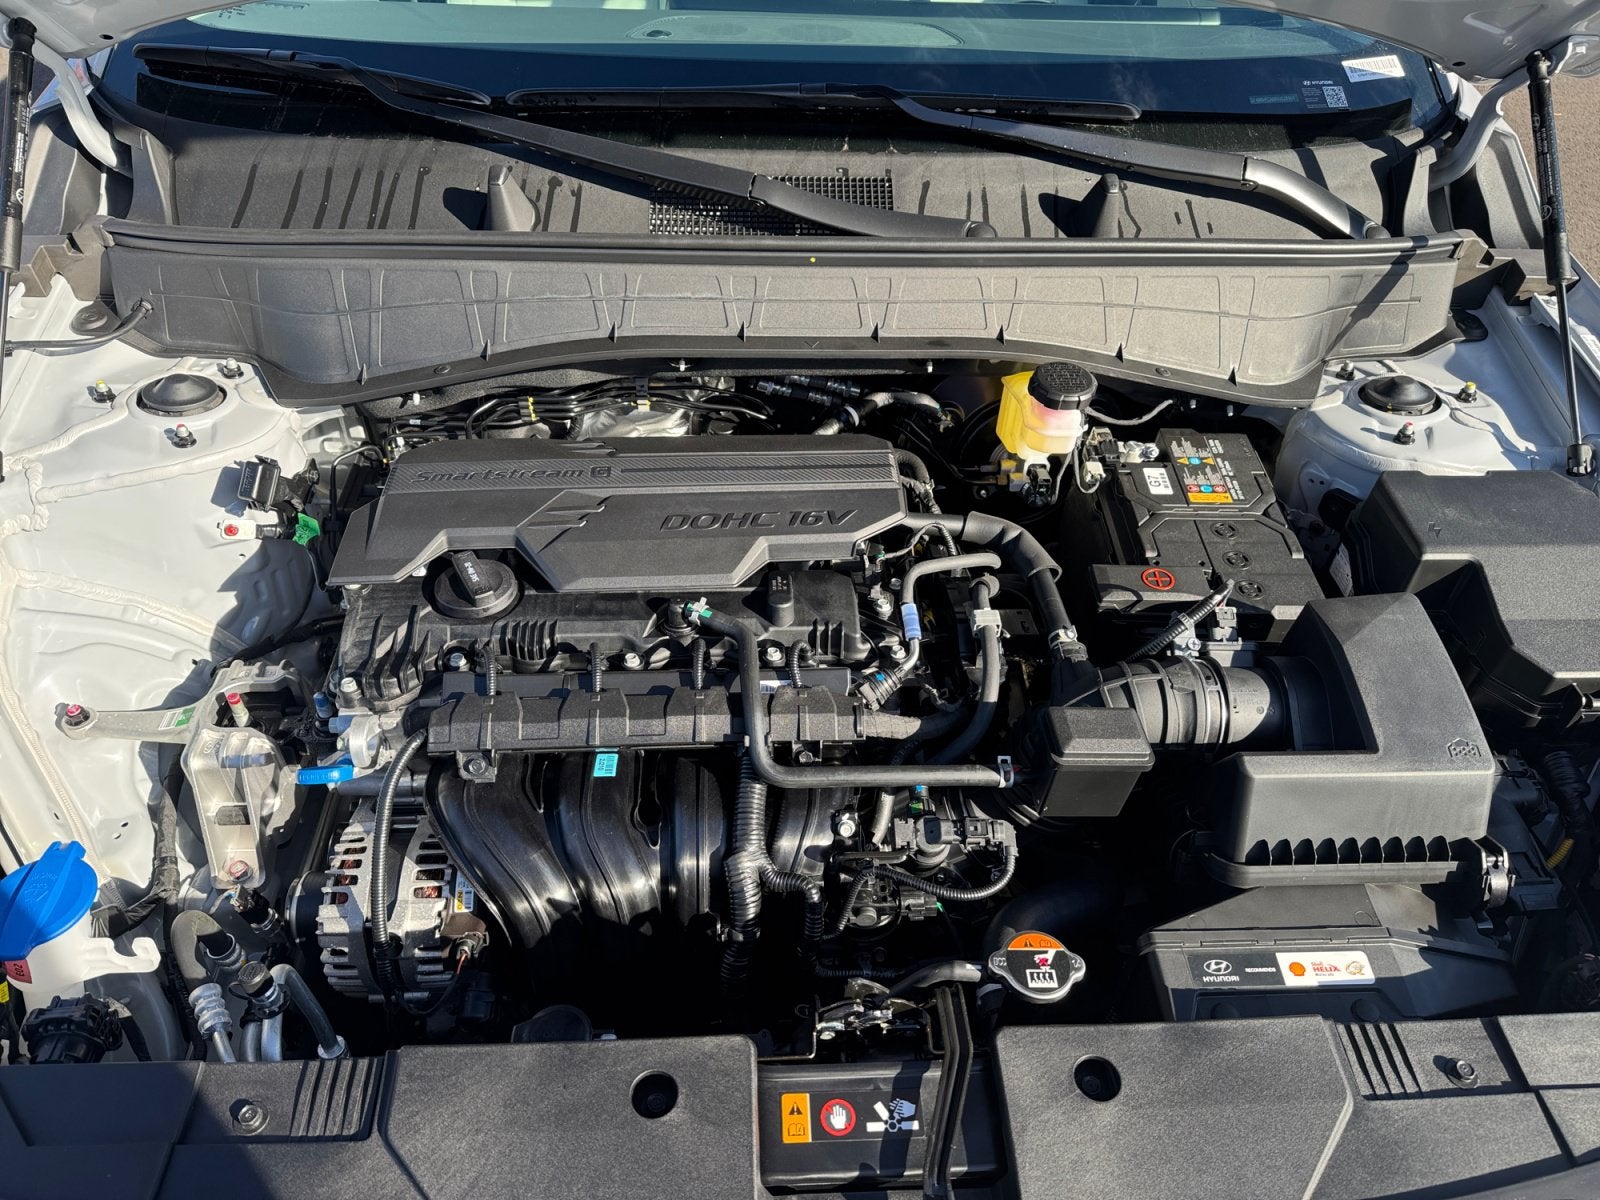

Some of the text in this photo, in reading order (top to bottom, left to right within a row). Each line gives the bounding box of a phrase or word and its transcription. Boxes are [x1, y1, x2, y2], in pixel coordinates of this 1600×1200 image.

[410, 468, 584, 483] Smartstream
[1148, 475, 1161, 488] G7
[660, 509, 858, 532] DOHC 16V
[1203, 975, 1240, 983] HYUNDAI
